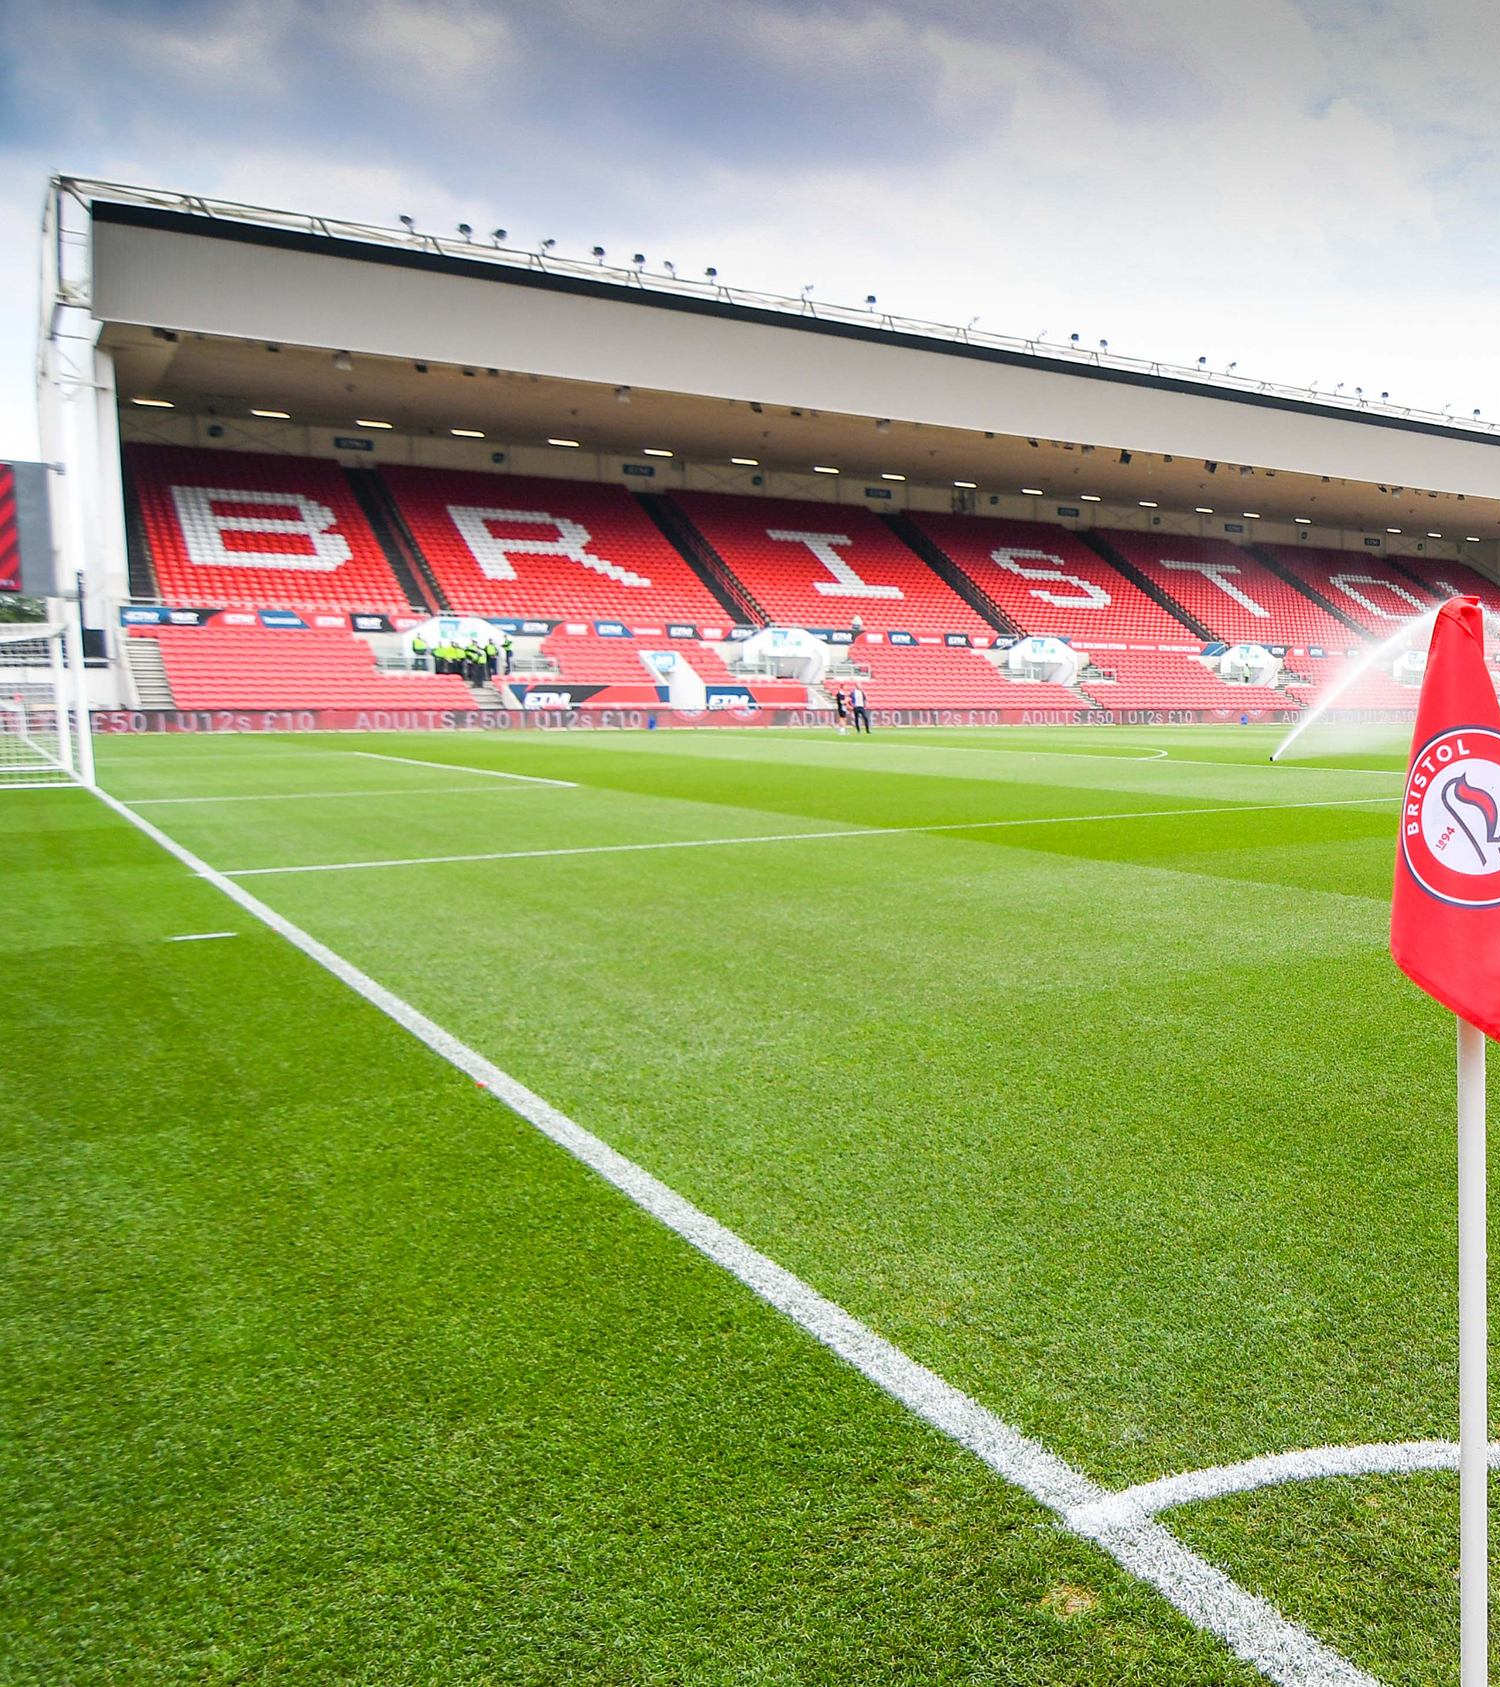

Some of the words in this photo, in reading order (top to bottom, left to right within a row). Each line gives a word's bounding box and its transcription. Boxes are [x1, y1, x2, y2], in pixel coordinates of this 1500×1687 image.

[178, 711, 252, 732] U12s
[263, 711, 316, 731] £10
[354, 711, 456, 731] ADULTS
[465, 711, 511, 730] £50
[535, 711, 593, 729] U12s
[601, 711, 643, 729] £10
[869, 711, 901, 726] £50
[919, 711, 962, 725] U12s
[968, 711, 999, 725] £10
[1021, 711, 1081, 725] ADULTS
[1086, 710, 1114, 724] £50
[1128, 710, 1163, 724] U12s
[1168, 710, 1193, 723] £10
[1407, 739, 1470, 836] BRISTOL
[1435, 826, 1456, 851] 1894
